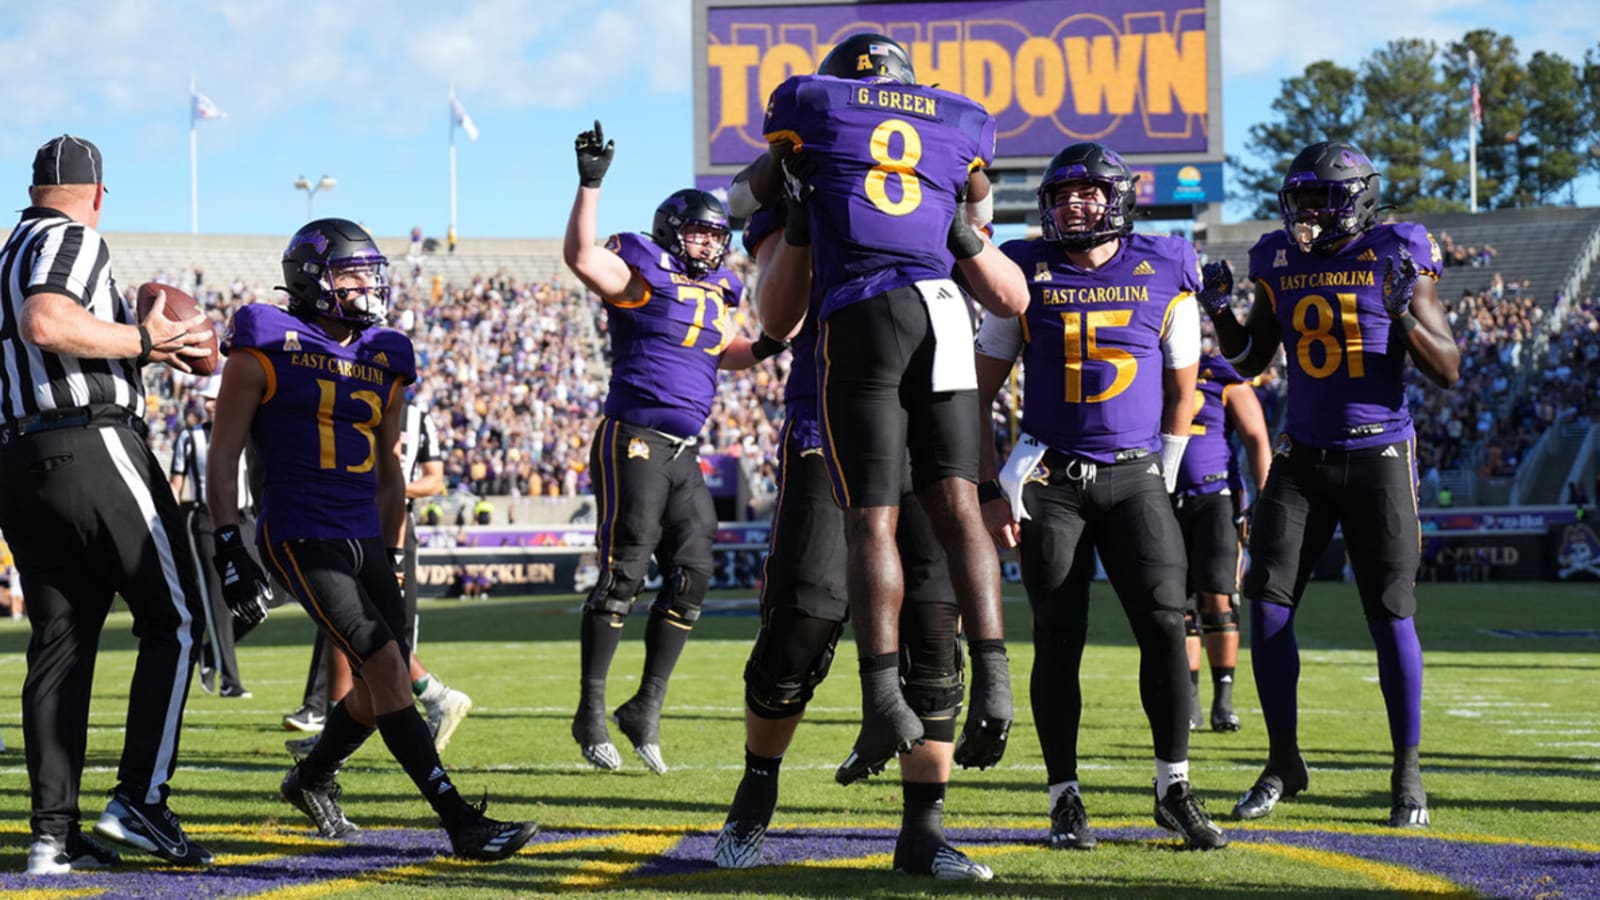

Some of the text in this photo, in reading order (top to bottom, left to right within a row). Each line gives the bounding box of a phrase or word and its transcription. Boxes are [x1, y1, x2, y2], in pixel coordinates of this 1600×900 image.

[708, 31, 1208, 128] TOHDOWN
[858, 88, 936, 117] G. GREEN
[864, 119, 922, 216] 8
[1043, 285, 1149, 304] EAST CAROLINA
[1280, 270, 1375, 291] EAST CAROLINA
[677, 286, 725, 356] 73
[1060, 309, 1138, 404] 15
[1292, 292, 1365, 379] 81
[291, 352, 384, 386] EAST CAROLIN
[317, 379, 382, 472] 13
